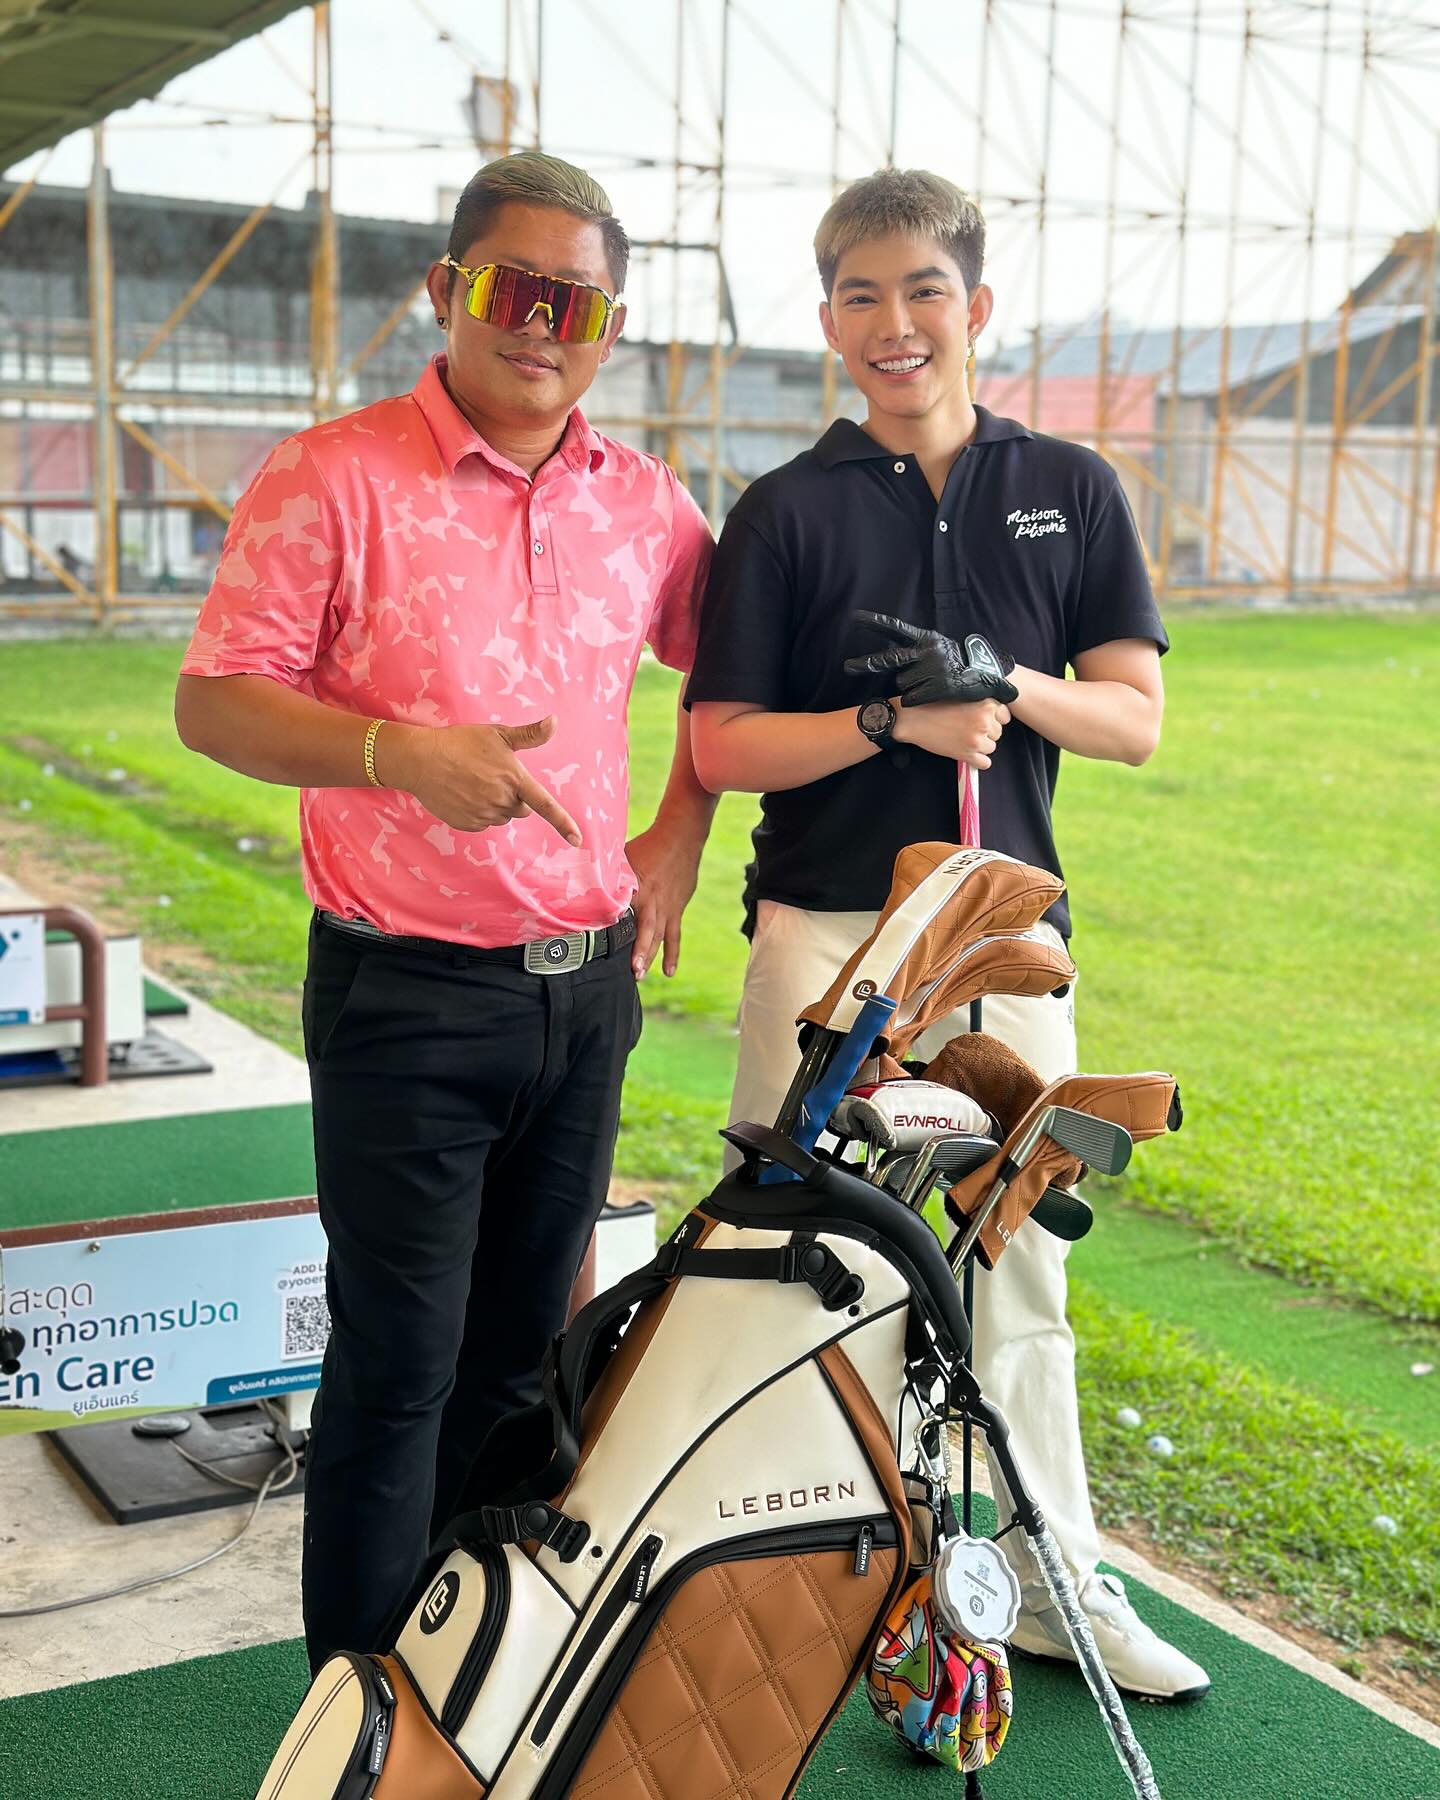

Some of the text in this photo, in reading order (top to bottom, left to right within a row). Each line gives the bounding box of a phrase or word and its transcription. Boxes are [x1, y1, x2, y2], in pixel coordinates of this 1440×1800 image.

[1006, 509, 1063, 526] Maison
[893, 1114, 967, 1132] EVNROLL
[277, 1275, 327, 1290] @yooen
[293, 1264, 317, 1274] ADD
[0, 1282, 93, 1319] สะดุด
[33, 1299, 239, 1356] ทุกอาการปวด
[57, 1356, 155, 1392] Care
[73, 1390, 139, 1416] ยูเอ็นแคร์
[718, 1480, 856, 1519] LEBORN
[859, 1538, 869, 1571] LEBORN
[634, 1565, 647, 1599] LEBORN
[373, 1735, 384, 1770] LEBORN
